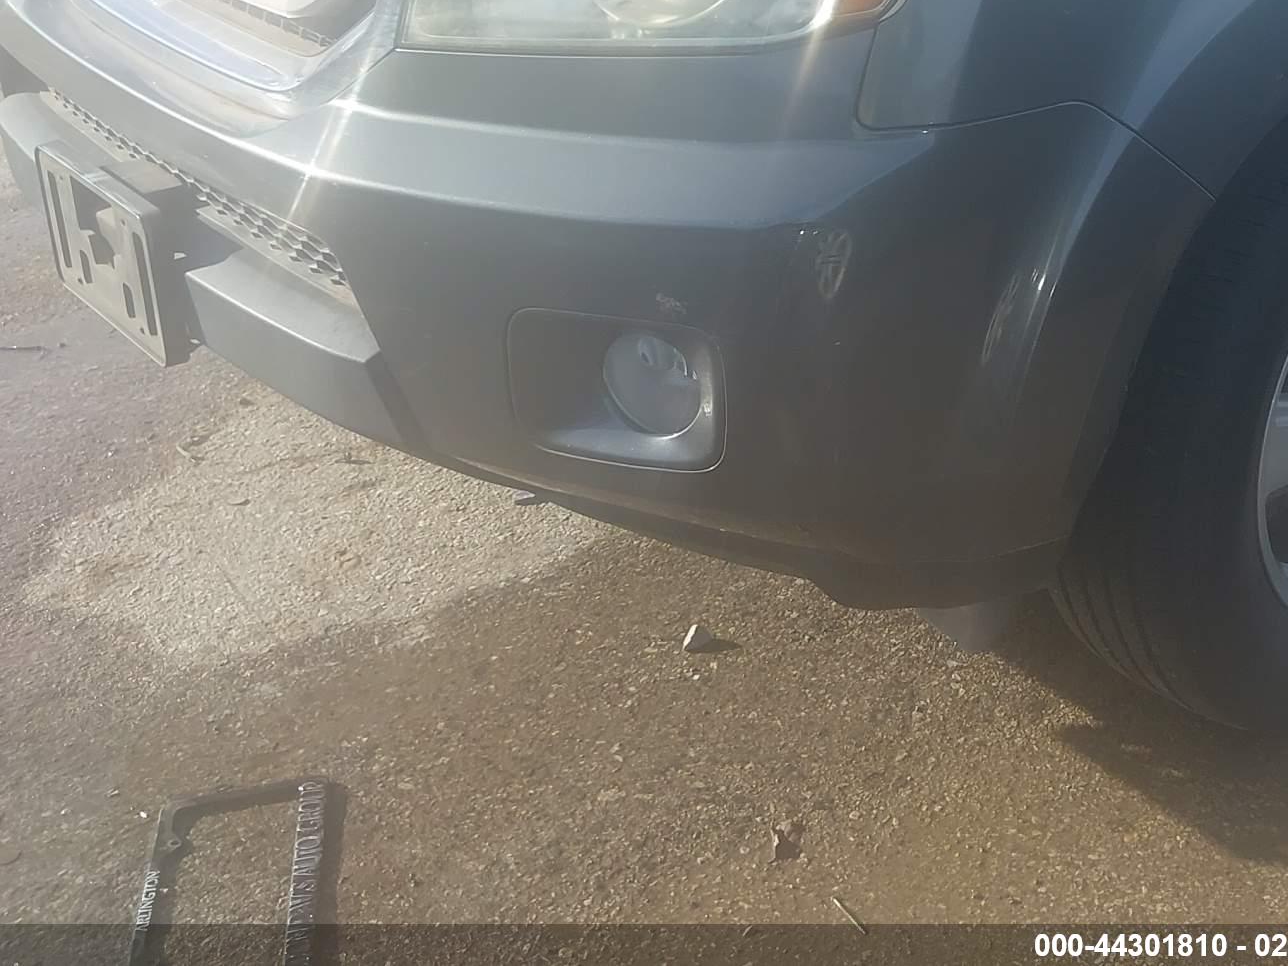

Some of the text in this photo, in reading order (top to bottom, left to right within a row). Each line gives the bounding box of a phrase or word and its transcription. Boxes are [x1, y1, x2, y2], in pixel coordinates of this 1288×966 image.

[297, 781, 325, 832] GROUP
[294, 836, 323, 876] AUTO
[136, 870, 161, 931] ARLINGTON
